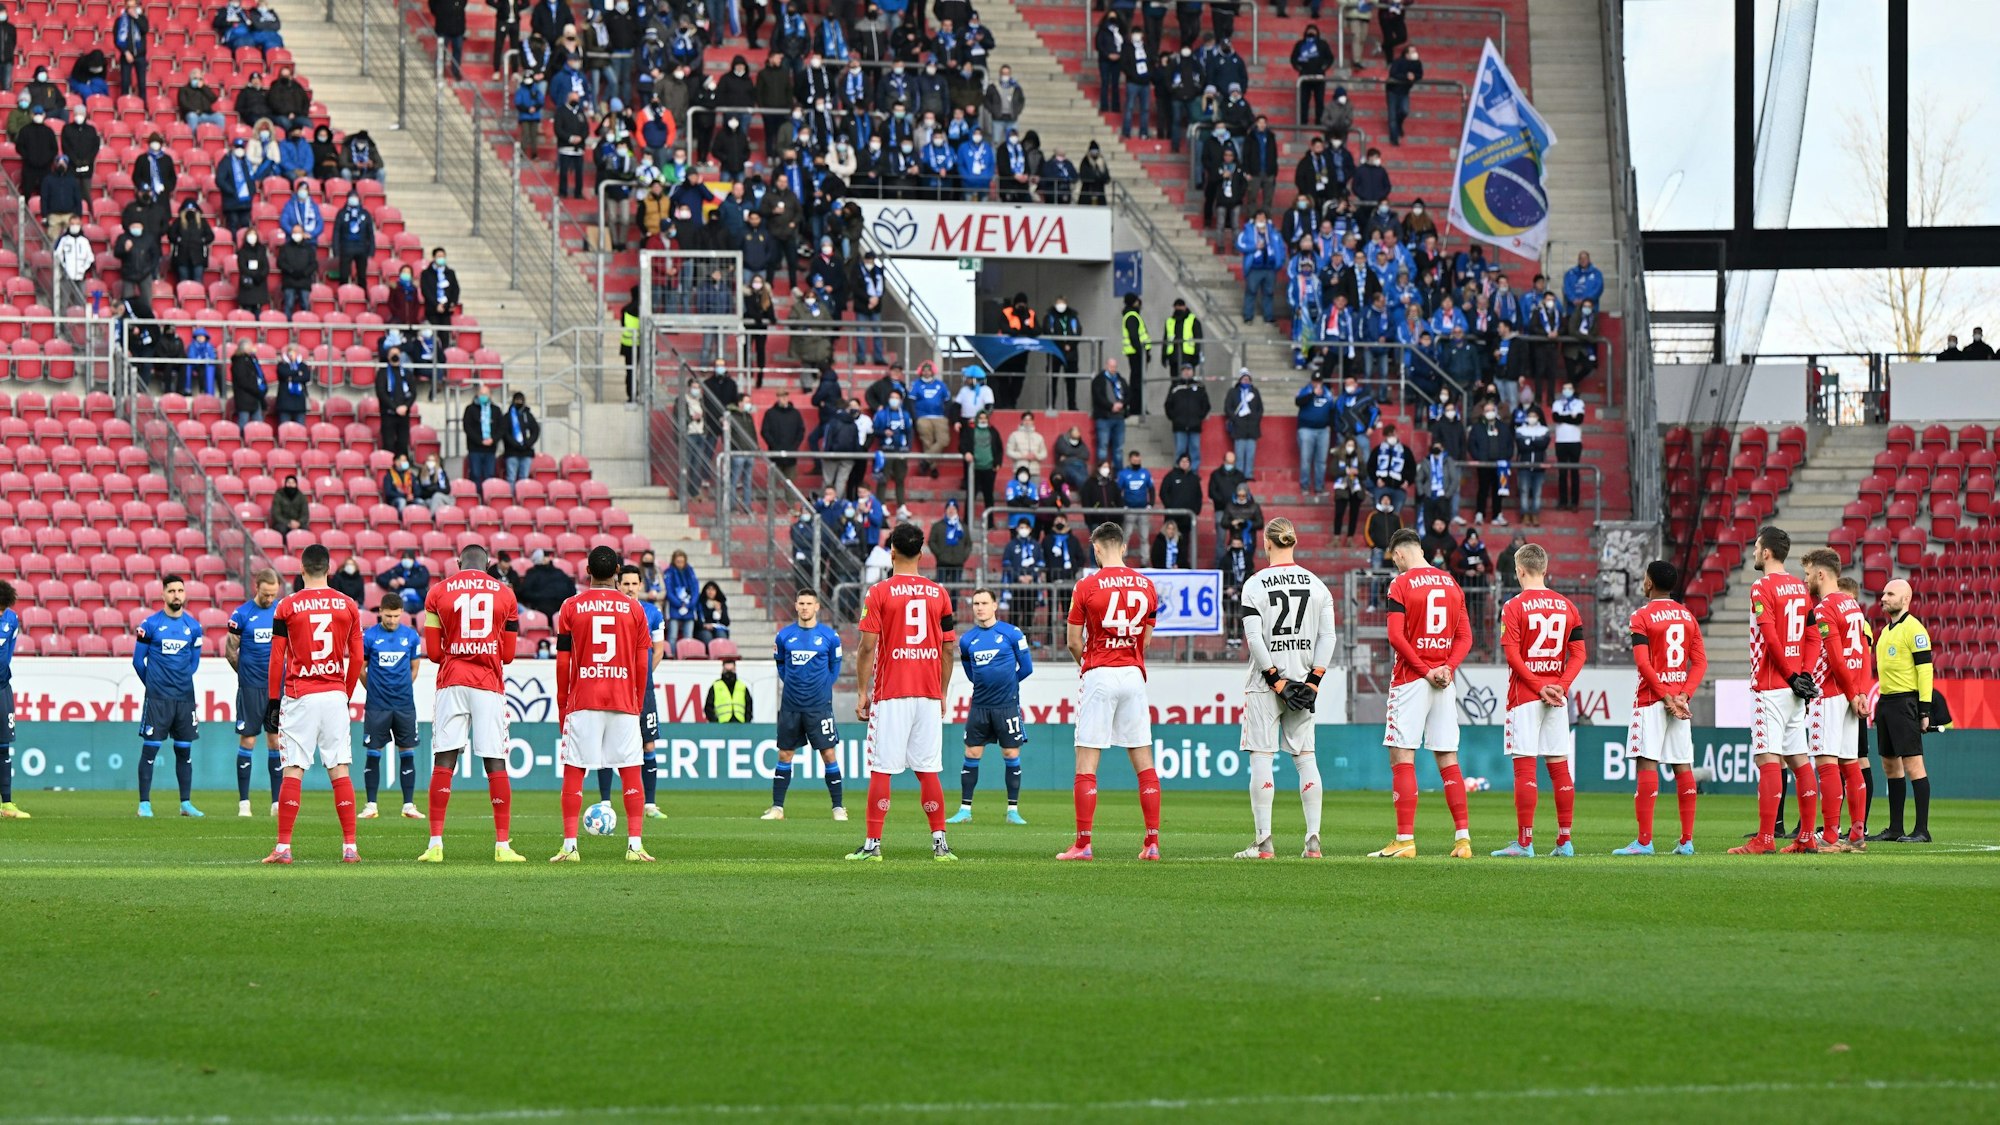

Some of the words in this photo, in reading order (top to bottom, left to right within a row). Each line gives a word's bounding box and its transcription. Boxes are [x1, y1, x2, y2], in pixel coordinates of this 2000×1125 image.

[931, 213, 1069, 254] MEWA
[446, 579, 485, 592] MAINZ
[486, 579, 501, 592] 05
[1098, 575, 1135, 590] MAINZ
[1135, 576, 1148, 589] 05
[1261, 574, 1297, 588] MAINZ
[1297, 574, 1311, 585] 05
[1409, 574, 1443, 589] MAINZ
[1441, 575, 1454, 587] 05
[890, 584, 925, 597] MAINZ
[925, 585, 940, 598] 05
[292, 598, 330, 613] MAINZ
[332, 598, 346, 610] 05
[576, 600, 614, 614] MAINZ
[615, 601, 630, 614] 05
[1268, 589, 1311, 636] 27
[1426, 589, 1447, 634] 6
[1521, 598, 1554, 612] MAINZ
[1554, 598, 1567, 611] 05
[453, 593, 494, 639] 19
[1101, 590, 1149, 637] 42
[1650, 609, 1682, 623] MAINZ
[1680, 609, 1692, 622] 05
[1784, 598, 1806, 643] 16
[905, 599, 928, 645] 9
[256, 631, 273, 639] SAP
[309, 613, 333, 661] 3
[592, 615, 616, 663] 5
[1528, 613, 1567, 658] 29
[163, 642, 181, 651] SAP
[450, 640, 498, 655] NIAKHATÉ
[1416, 637, 1453, 650] STACH
[1666, 623, 1685, 668] 8
[380, 654, 399, 663] SAP
[792, 653, 810, 662] SAP
[892, 647, 939, 660] ONISIWO
[975, 653, 993, 662] SAP
[580, 663, 629, 680] BOËTIUS
[646, 712, 658, 728] 21
[821, 718, 834, 735] 27
[1006, 716, 1020, 734] 17
